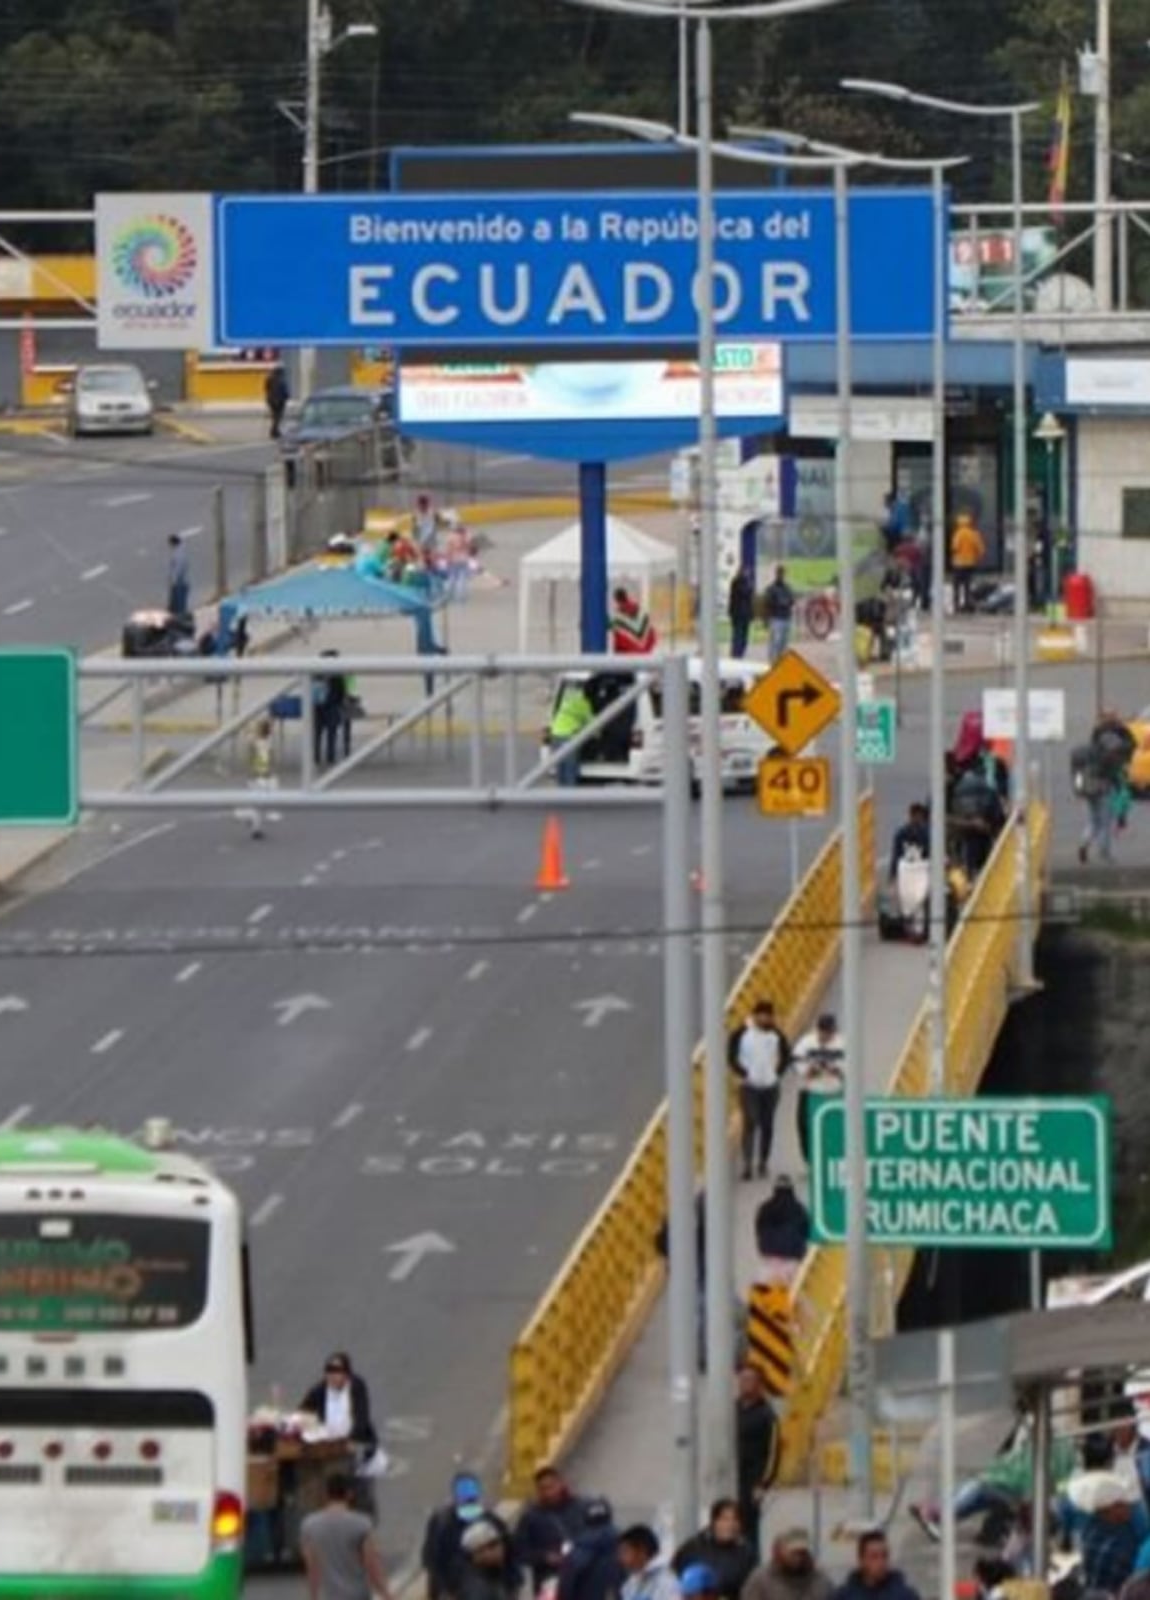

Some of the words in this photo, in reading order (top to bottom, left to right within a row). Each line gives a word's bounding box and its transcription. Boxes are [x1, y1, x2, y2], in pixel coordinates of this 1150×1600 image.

[350, 214, 524, 243] Bienvenido
[533, 220, 551, 242] a
[562, 214, 589, 241] la
[601, 211, 753, 245] Repúbca
[764, 211, 810, 240] del
[349, 261, 811, 326] ECUADOR
[768, 767, 821, 792] 40
[398, 1129, 618, 1150] TAXIS
[875, 1111, 1042, 1152] PUENTE
[360, 1155, 600, 1175] SOLO
